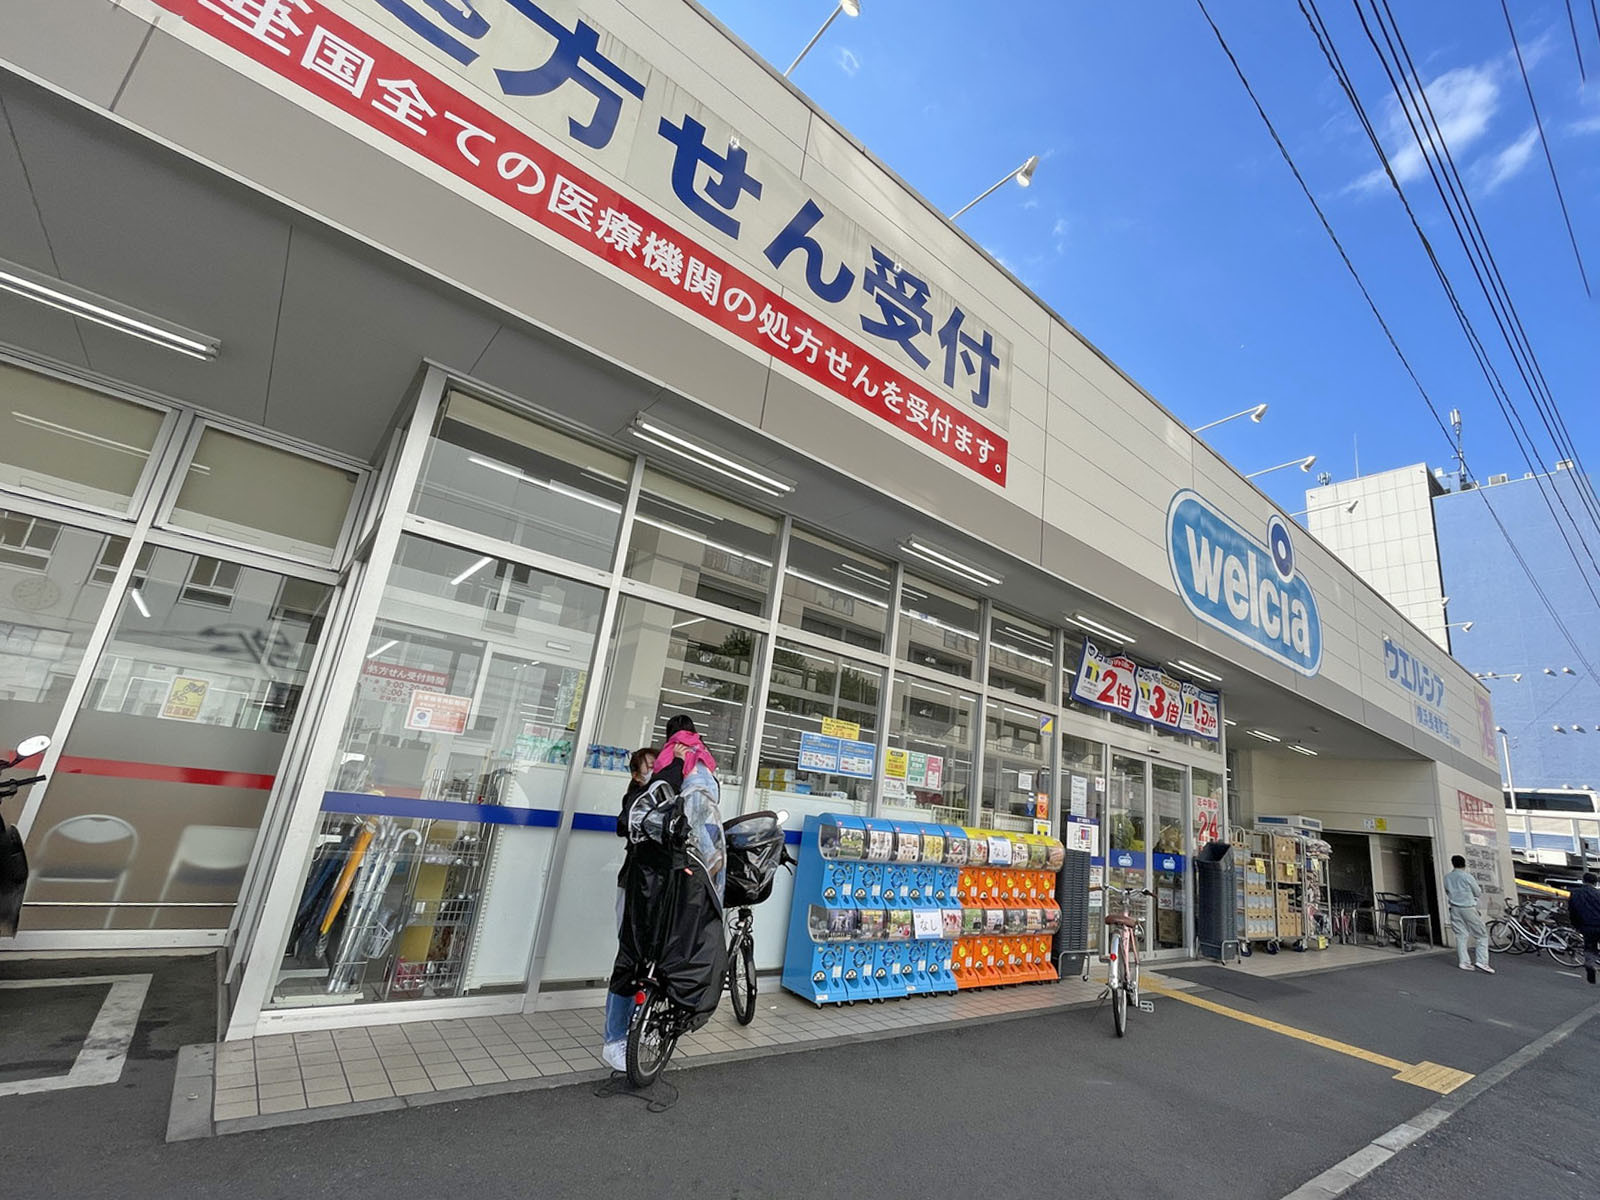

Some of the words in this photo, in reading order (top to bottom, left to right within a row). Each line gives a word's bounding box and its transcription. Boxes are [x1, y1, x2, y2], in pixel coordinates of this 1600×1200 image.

[1185, 522, 1311, 658] welcia
[1384, 638, 1444, 707] ウエルシア
[1198, 811, 1218, 842] 24
[993, 847, 1008, 857] なし
[920, 919, 938, 932] なし
